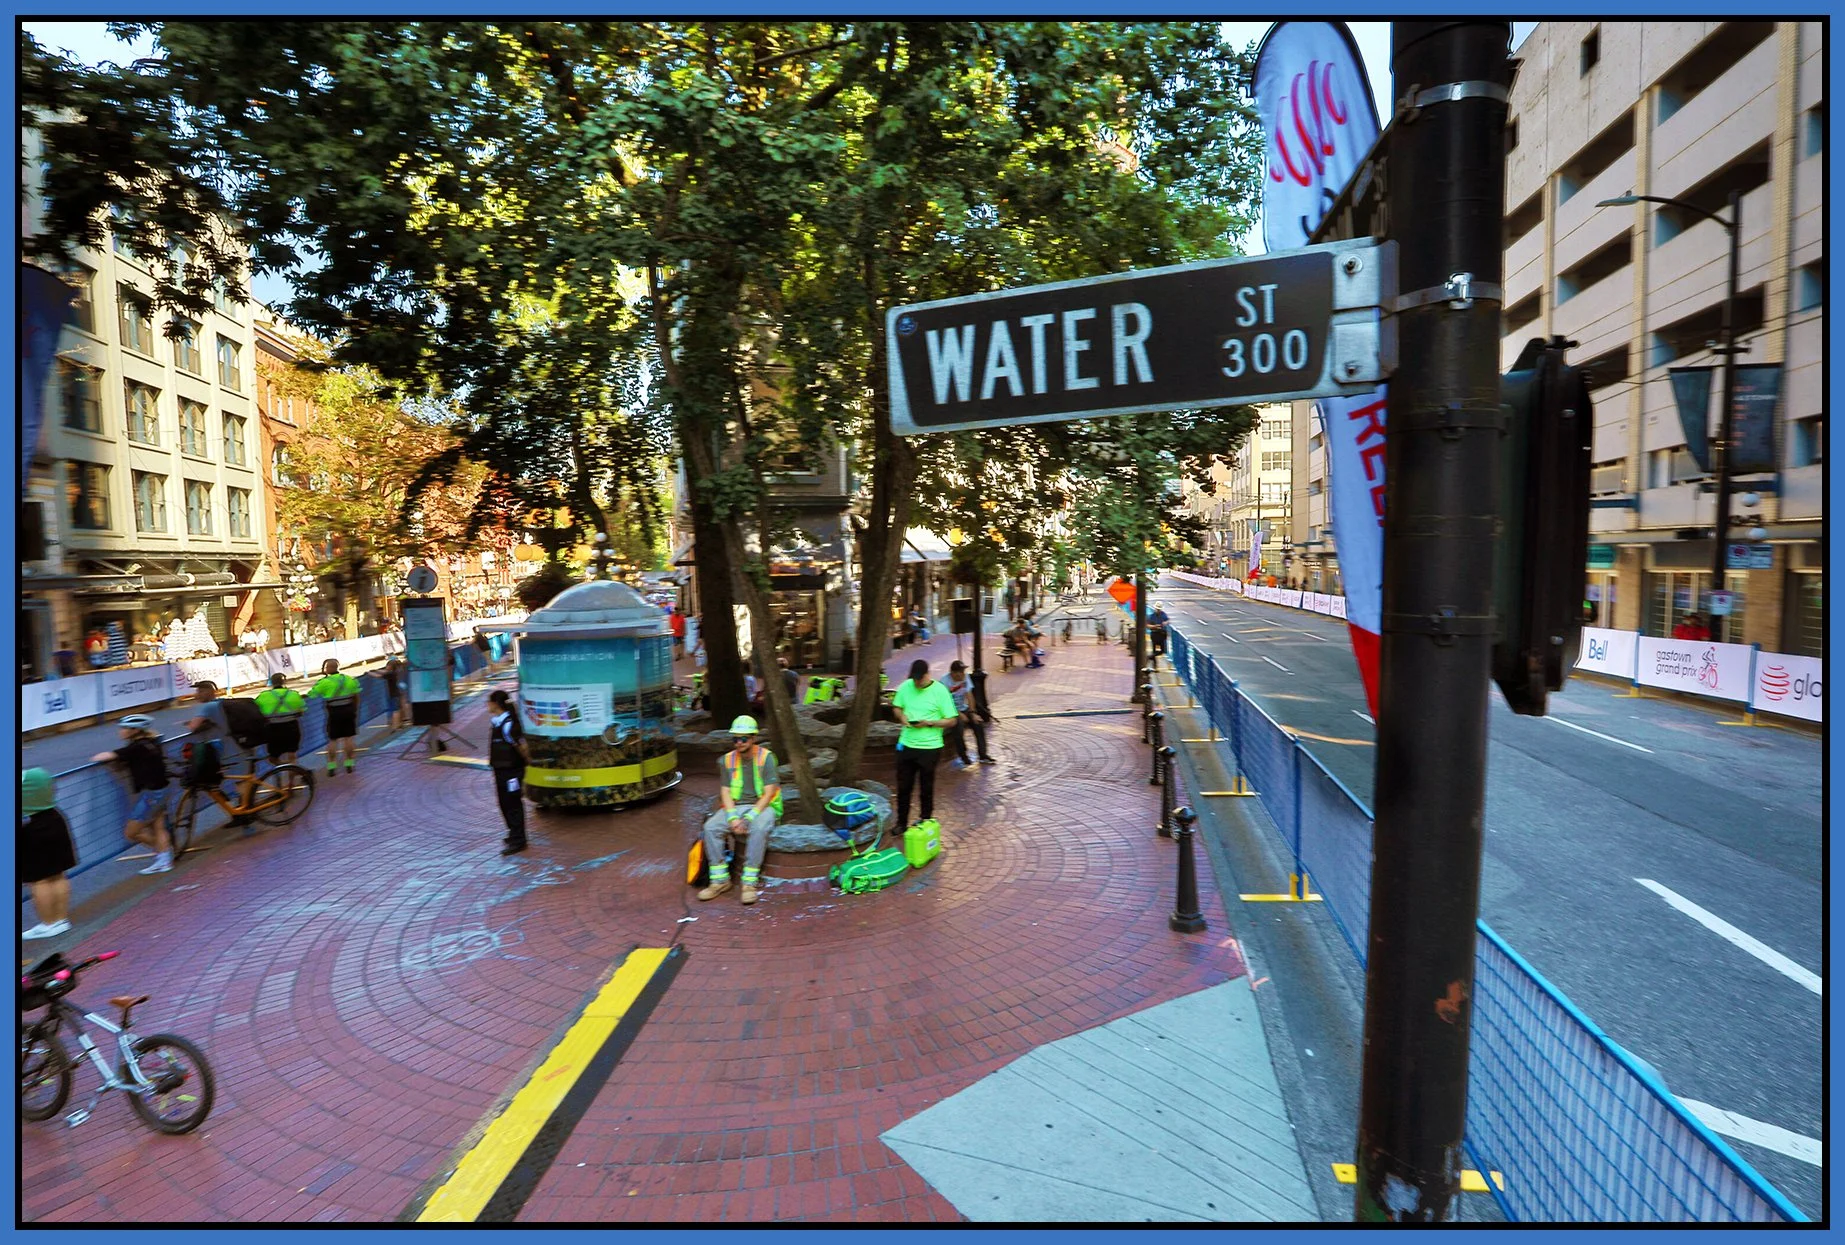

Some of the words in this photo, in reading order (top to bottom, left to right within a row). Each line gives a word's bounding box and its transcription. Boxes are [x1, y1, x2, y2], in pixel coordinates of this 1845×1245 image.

[1235, 283, 1277, 328] ST
[925, 300, 1154, 406] WATER
[1221, 328, 1309, 378] 300
[1588, 638, 1609, 661] Bell
[1656, 649, 1692, 662] gastown
[1655, 662, 1680, 675] grand
[1681, 664, 1698, 678] prix
[1793, 673, 1822, 701] glo
